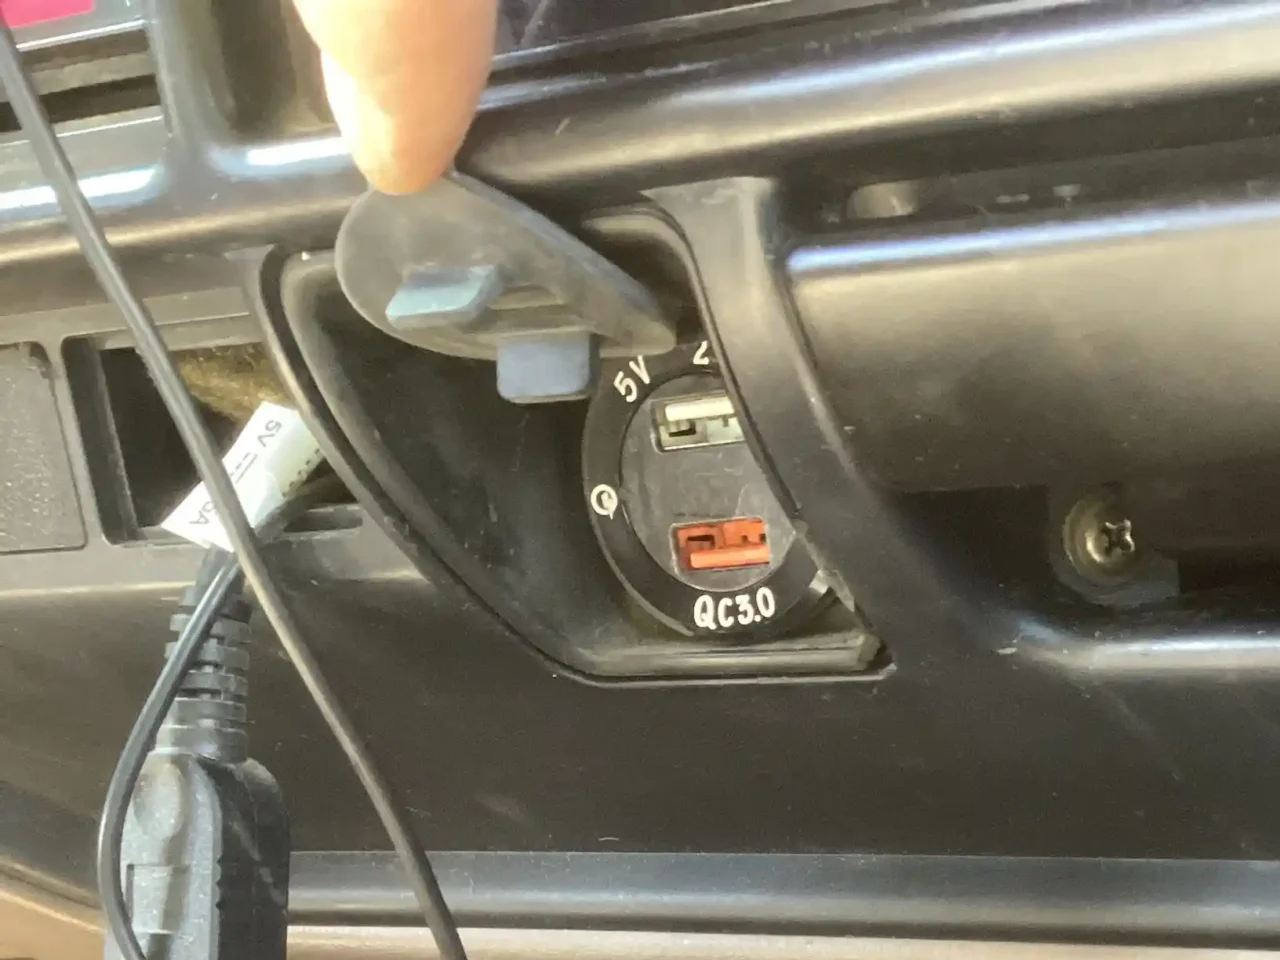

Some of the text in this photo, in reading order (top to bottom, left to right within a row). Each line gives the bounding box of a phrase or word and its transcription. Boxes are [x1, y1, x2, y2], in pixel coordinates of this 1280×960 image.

[613, 354, 651, 403] 5V
[257, 420, 282, 448] 5V
[693, 587, 776, 630] QC3.0
